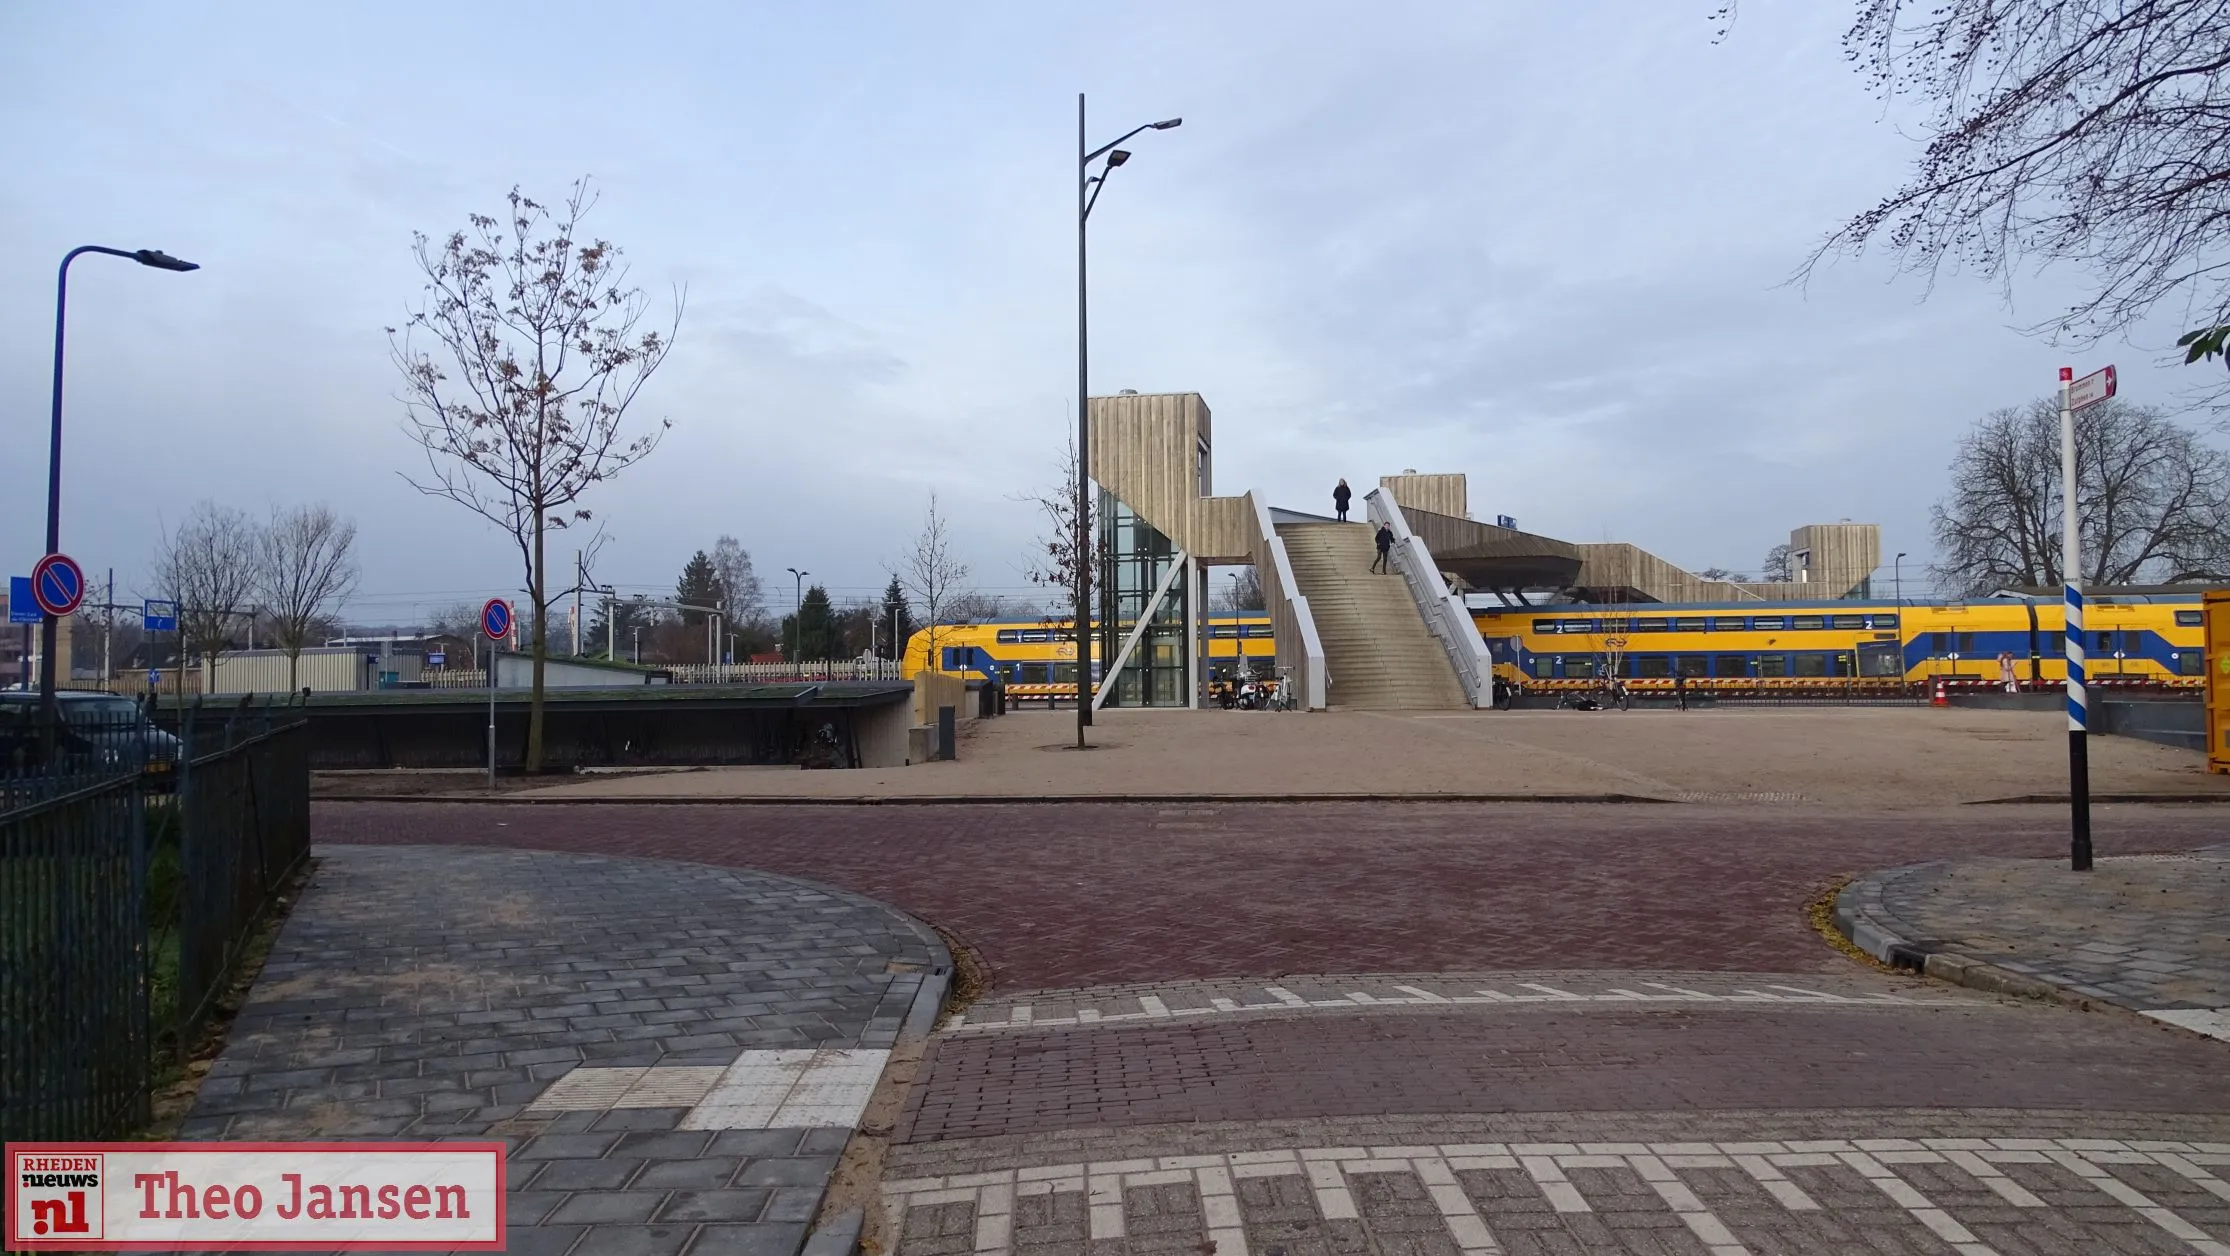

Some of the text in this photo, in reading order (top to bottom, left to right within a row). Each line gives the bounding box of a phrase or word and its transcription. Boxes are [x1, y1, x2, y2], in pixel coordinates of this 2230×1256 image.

[1556, 624, 1563, 634] 2
[1865, 620, 1873, 630] 2
[1017, 635, 1022, 643] 1
[1555, 655, 1562, 665] 2
[1015, 663, 1020, 671] 1
